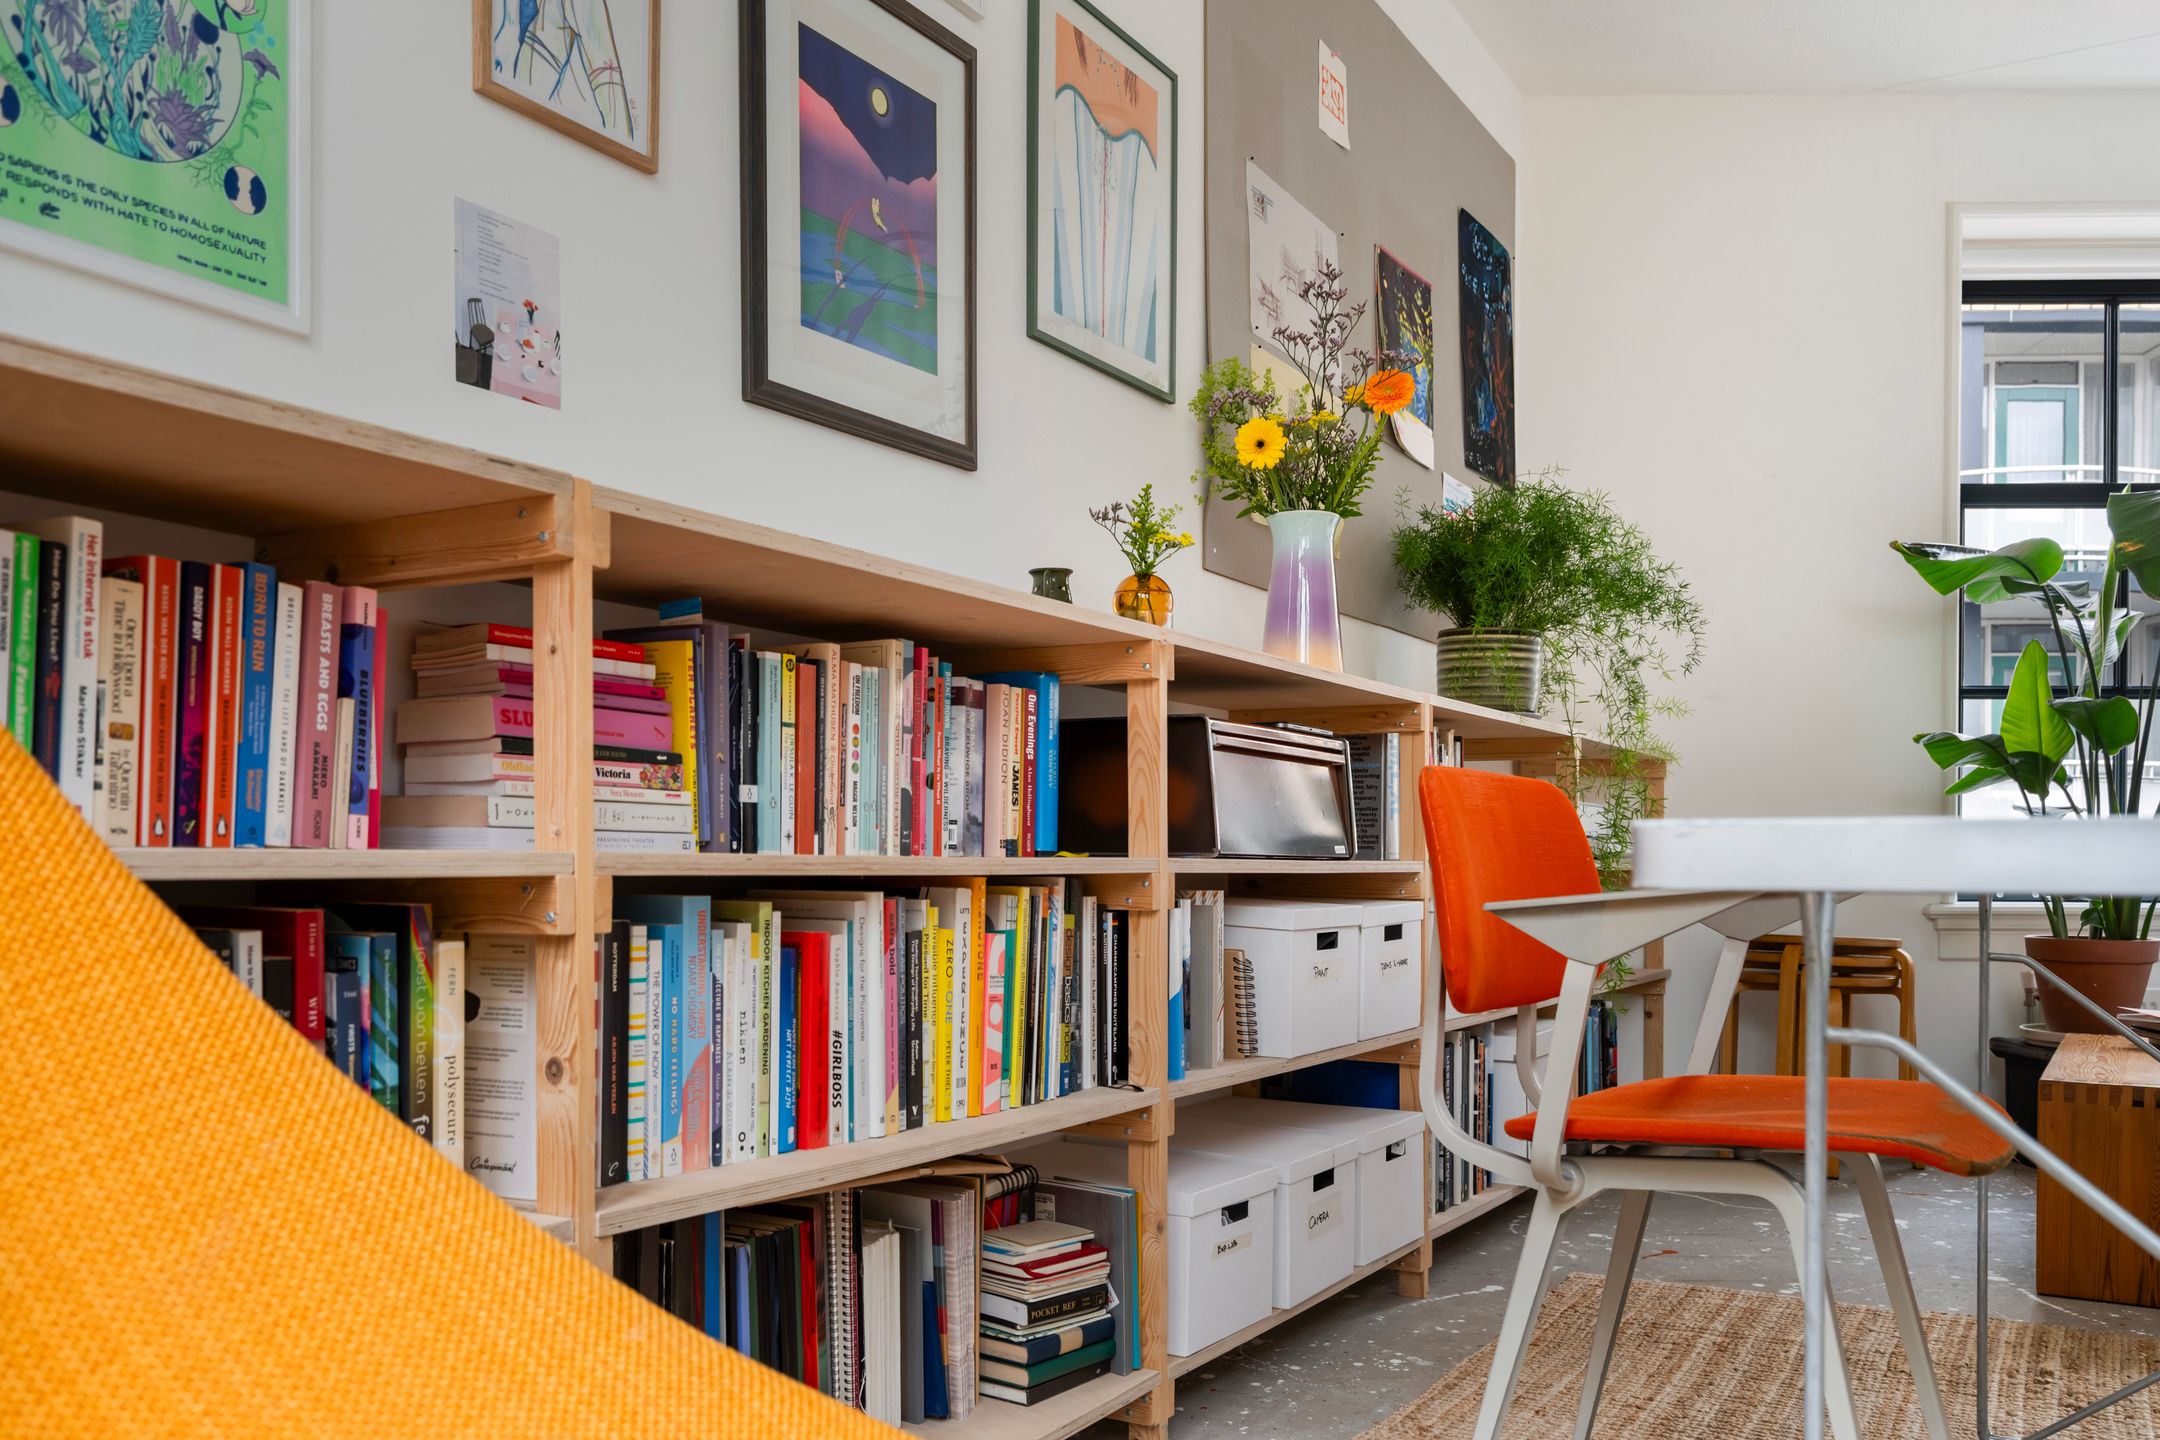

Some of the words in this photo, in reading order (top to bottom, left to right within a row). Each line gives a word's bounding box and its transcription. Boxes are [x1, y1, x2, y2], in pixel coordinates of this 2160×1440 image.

[6, 170, 78, 203] RESPONDS
[83, 196, 114, 215] WITH
[117, 208, 149, 226] HATE
[152, 219, 168, 232] TO
[170, 226, 266, 264] HOMOSEXUALITY
[8, 154, 59, 180] SAPIENS
[62, 173, 72, 185] IS
[77, 178, 97, 194] THE
[100, 186, 129, 203] ONLY
[132, 196, 177, 220] SPECIES
[178, 212, 188, 223] IN
[191, 217, 209, 231] ALL
[211, 224, 225, 233] OF
[227, 229, 267, 250] NATURE
[86, 534, 98, 558] Het
[52, 549, 61, 578] How
[51, 580, 61, 600] Do
[85, 560, 97, 613] internet
[193, 586, 204, 620] DADDY
[254, 573, 267, 615] BORN
[51, 602, 61, 627] You
[84, 616, 96, 628] is
[114, 600, 127, 630] Time
[161, 616, 169, 637] VAN
[225, 597, 234, 625] ROBIN
[253, 618, 265, 637] TO
[286, 597, 296, 630] URSULA
[320, 593, 334, 655] BREASTS
[50, 629, 60, 661] Live?
[83, 631, 95, 660] stuk
[113, 633, 126, 645] in
[126, 618, 138, 651] Once
[161, 638, 169, 655] DER
[192, 621, 203, 641] BOY
[224, 627, 232, 649] WALL
[122, 654, 137, 687] Upon
[160, 656, 168, 681] KOLK
[252, 640, 264, 672] RUN
[831, 650, 839, 681] ALMA
[110, 647, 125, 715] Hollywood
[318, 656, 332, 690] AND
[78, 685, 89, 734] Marleen
[124, 689, 134, 699] a
[1001, 690, 1010, 728] JOAN
[1027, 695, 1037, 713] Our
[282, 707, 290, 728] LEFT
[316, 693, 330, 732] EGGS
[357, 669, 371, 773] BLUEBERRIES
[689, 688, 697, 750] PLANETS
[280, 730, 288, 754] HAND
[1025, 715, 1036, 760] Evenings
[76, 737, 88, 779] Stikker
[280, 757, 288, 767] OF
[311, 741, 322, 800] KAWAKAMI
[320, 755, 329, 789] MIEKO
[595, 767, 631, 779] Victoria
[1001, 734, 1009, 784] DIDION
[109, 750, 122, 810] Tarantino
[119, 761, 133, 812] Quentin
[277, 770, 287, 815] DARKNESS
[512, 783, 529, 793] HOW
[610, 789, 622, 798] Vera
[1011, 765, 1020, 807] JAMES
[763, 919, 771, 962] INDOOR
[858, 916, 866, 958] Designs
[888, 913, 896, 946] extra
[697, 910, 707, 996] UNDERSTANDING
[888, 948, 896, 976] bold
[946, 939, 954, 978] ZERO
[1064, 928, 1073, 976] design
[416, 946, 428, 993] joost
[448, 967, 457, 997] FERN
[653, 971, 661, 988] THE
[688, 956, 697, 986] NOAM
[653, 993, 661, 1031] POWER
[671, 996, 679, 1015] NO
[945, 991, 953, 1024] ONE
[959, 922, 969, 1069] EXPERIENCE
[1064, 977, 1073, 1024] basics
[308, 997, 319, 1029] WHY
[416, 998, 427, 1038] van
[688, 989, 697, 1040] CHOMSKY
[697, 1000, 707, 1039] POWER
[653, 1033, 661, 1047] OF
[739, 1010, 749, 1065] niksen
[762, 1012, 770, 1076] GARDENING
[416, 1041, 428, 1105] bellen
[652, 1051, 660, 1079] NOW
[832, 1030, 842, 1108] #GIRLBOSS
[445, 1055, 460, 1146] polysecure
[670, 1058, 678, 1115] FEELINGS
[1031, 1304, 1060, 1320] POCKET
[1062, 1300, 1078, 1312] REF
